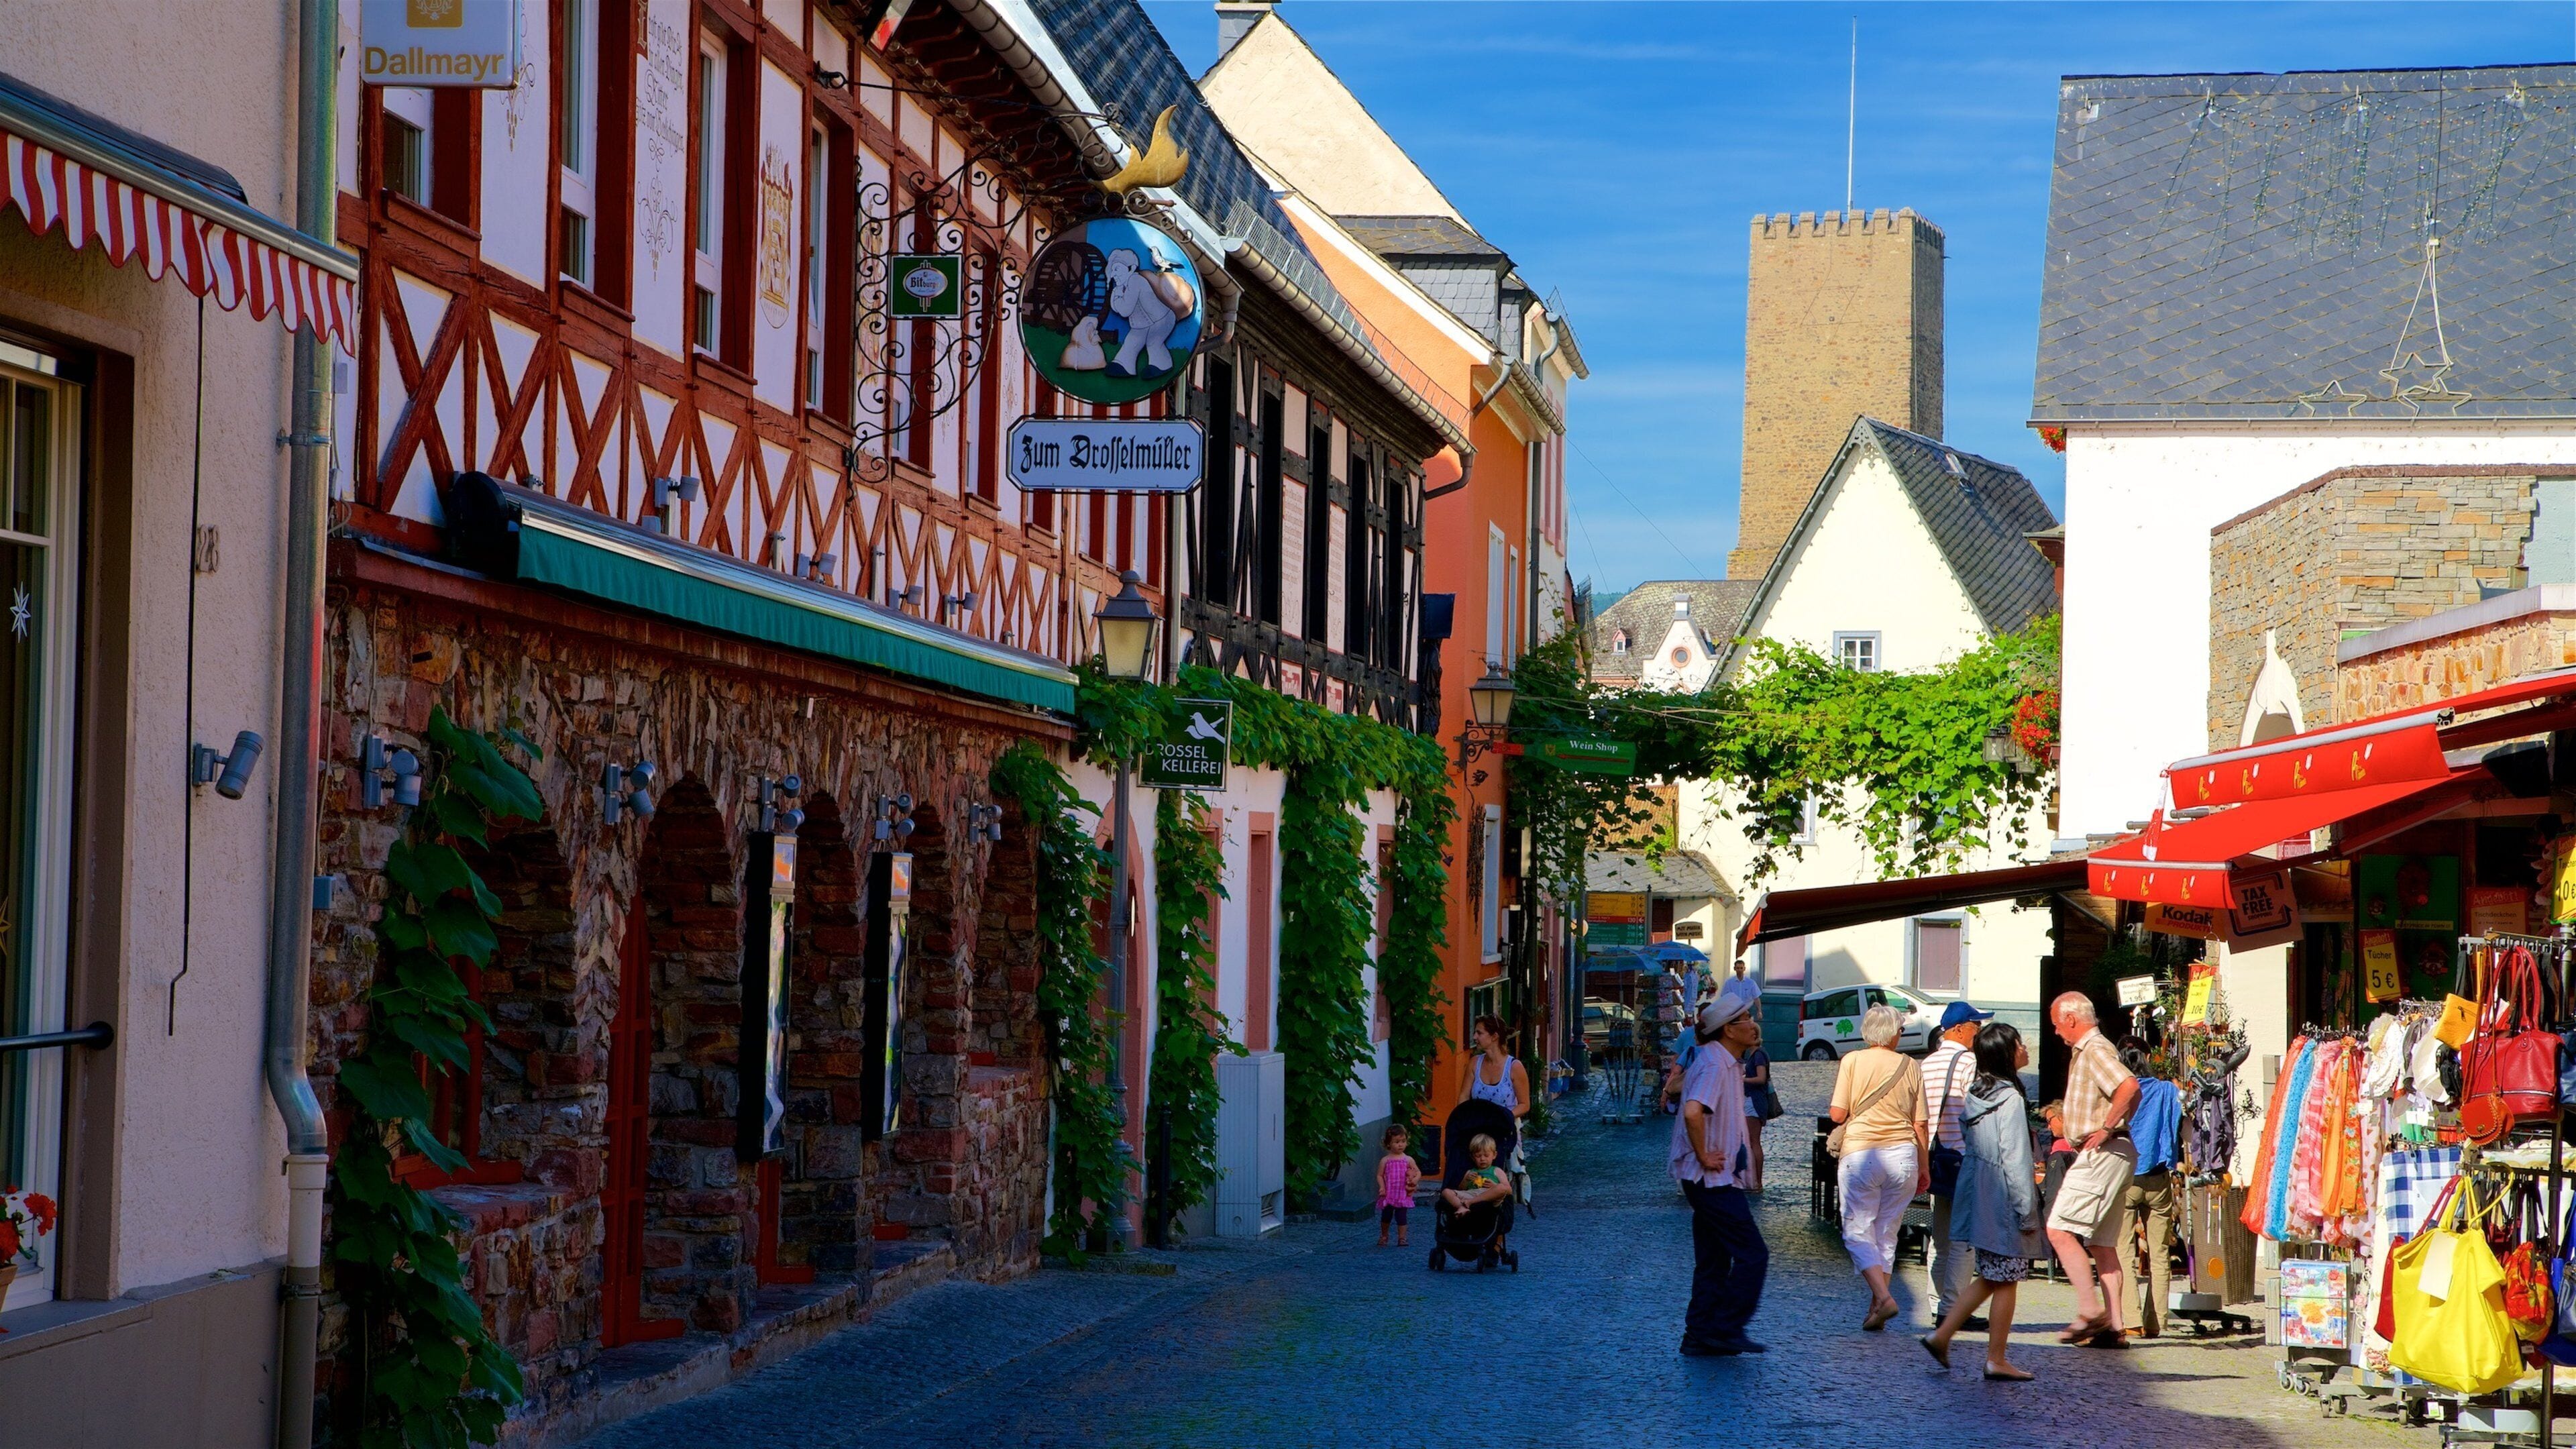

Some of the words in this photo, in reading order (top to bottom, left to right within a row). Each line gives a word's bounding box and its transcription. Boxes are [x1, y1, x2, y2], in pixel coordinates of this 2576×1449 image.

[364, 47, 504, 82] Dallmayr
[910, 277, 941, 289] Bitburg
[1020, 434, 1060, 474] Zum
[1146, 739, 1208, 759] DROSSEL
[1570, 741, 1593, 750] Wein
[1595, 742, 1618, 753] Shop
[1162, 759, 1221, 775] KELLEREI
[2241, 885, 2268, 902] TAX
[2556, 881, 2569, 901] 10
[2162, 906, 2213, 925] Kodak
[2242, 898, 2274, 916] FREE
[2367, 950, 2392, 959] Tücher
[2372, 969, 2381, 988] 5
[2385, 973, 2394, 988] €
